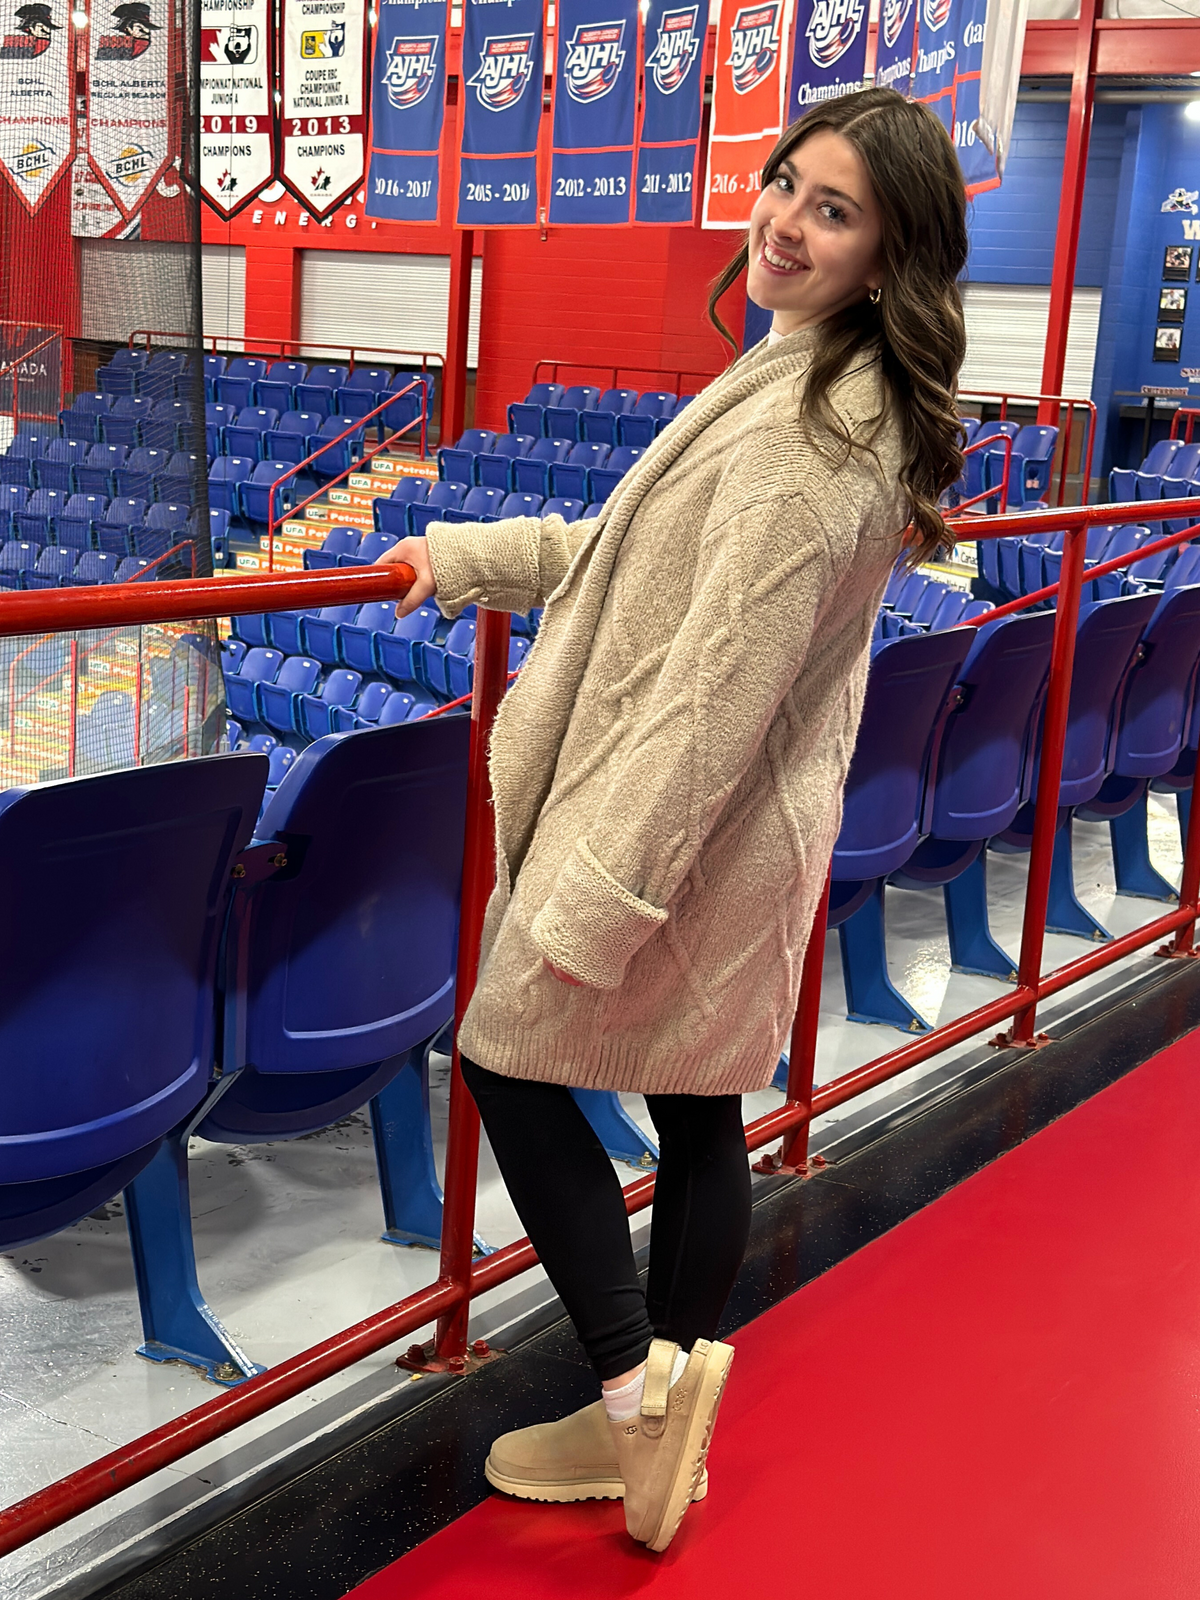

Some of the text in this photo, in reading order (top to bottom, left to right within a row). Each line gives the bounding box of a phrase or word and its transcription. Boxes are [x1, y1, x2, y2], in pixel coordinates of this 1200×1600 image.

[302, 2, 346, 15] CHAMPIONSHIP
[809, 0, 862, 39] AJHL
[655, 29, 693, 67] AJHL
[730, 25, 779, 68] AJHL
[566, 42, 620, 78] AJHL
[305, 69, 327, 81] COUPE
[386, 56, 432, 85] AJHL
[479, 54, 528, 87] AJHL
[92, 80, 166, 88] BCHL ALBERTA
[231, 77, 263, 89] NATIONAL
[300, 81, 341, 94] CHAMPIONNAT
[10, 89, 53, 97] ALBERTA
[91, 91, 166, 99] REGULAR SEASON
[797, 77, 862, 105] Champions
[211, 93, 239, 104] JUNIOR A
[292, 94, 350, 108] NATIONAL JUNIOR A
[91, 118, 167, 128] CHAMPIONS
[200, 116, 258, 133] 2019
[292, 116, 351, 136] 2013
[203, 145, 252, 157] CHAMPIONS
[297, 144, 345, 157] CHAMPIONS
[17, 153, 49, 169] BCHL
[115, 157, 148, 174] BCHL
[373, 462, 392, 470] UFA
[351, 478, 369, 486] UFA
[331, 493, 349, 502] UFA
[285, 526, 304, 534] UFA
[262, 541, 281, 550] UA
[239, 558, 257, 567] UFA
[623, 1425, 638, 1435] UGG
